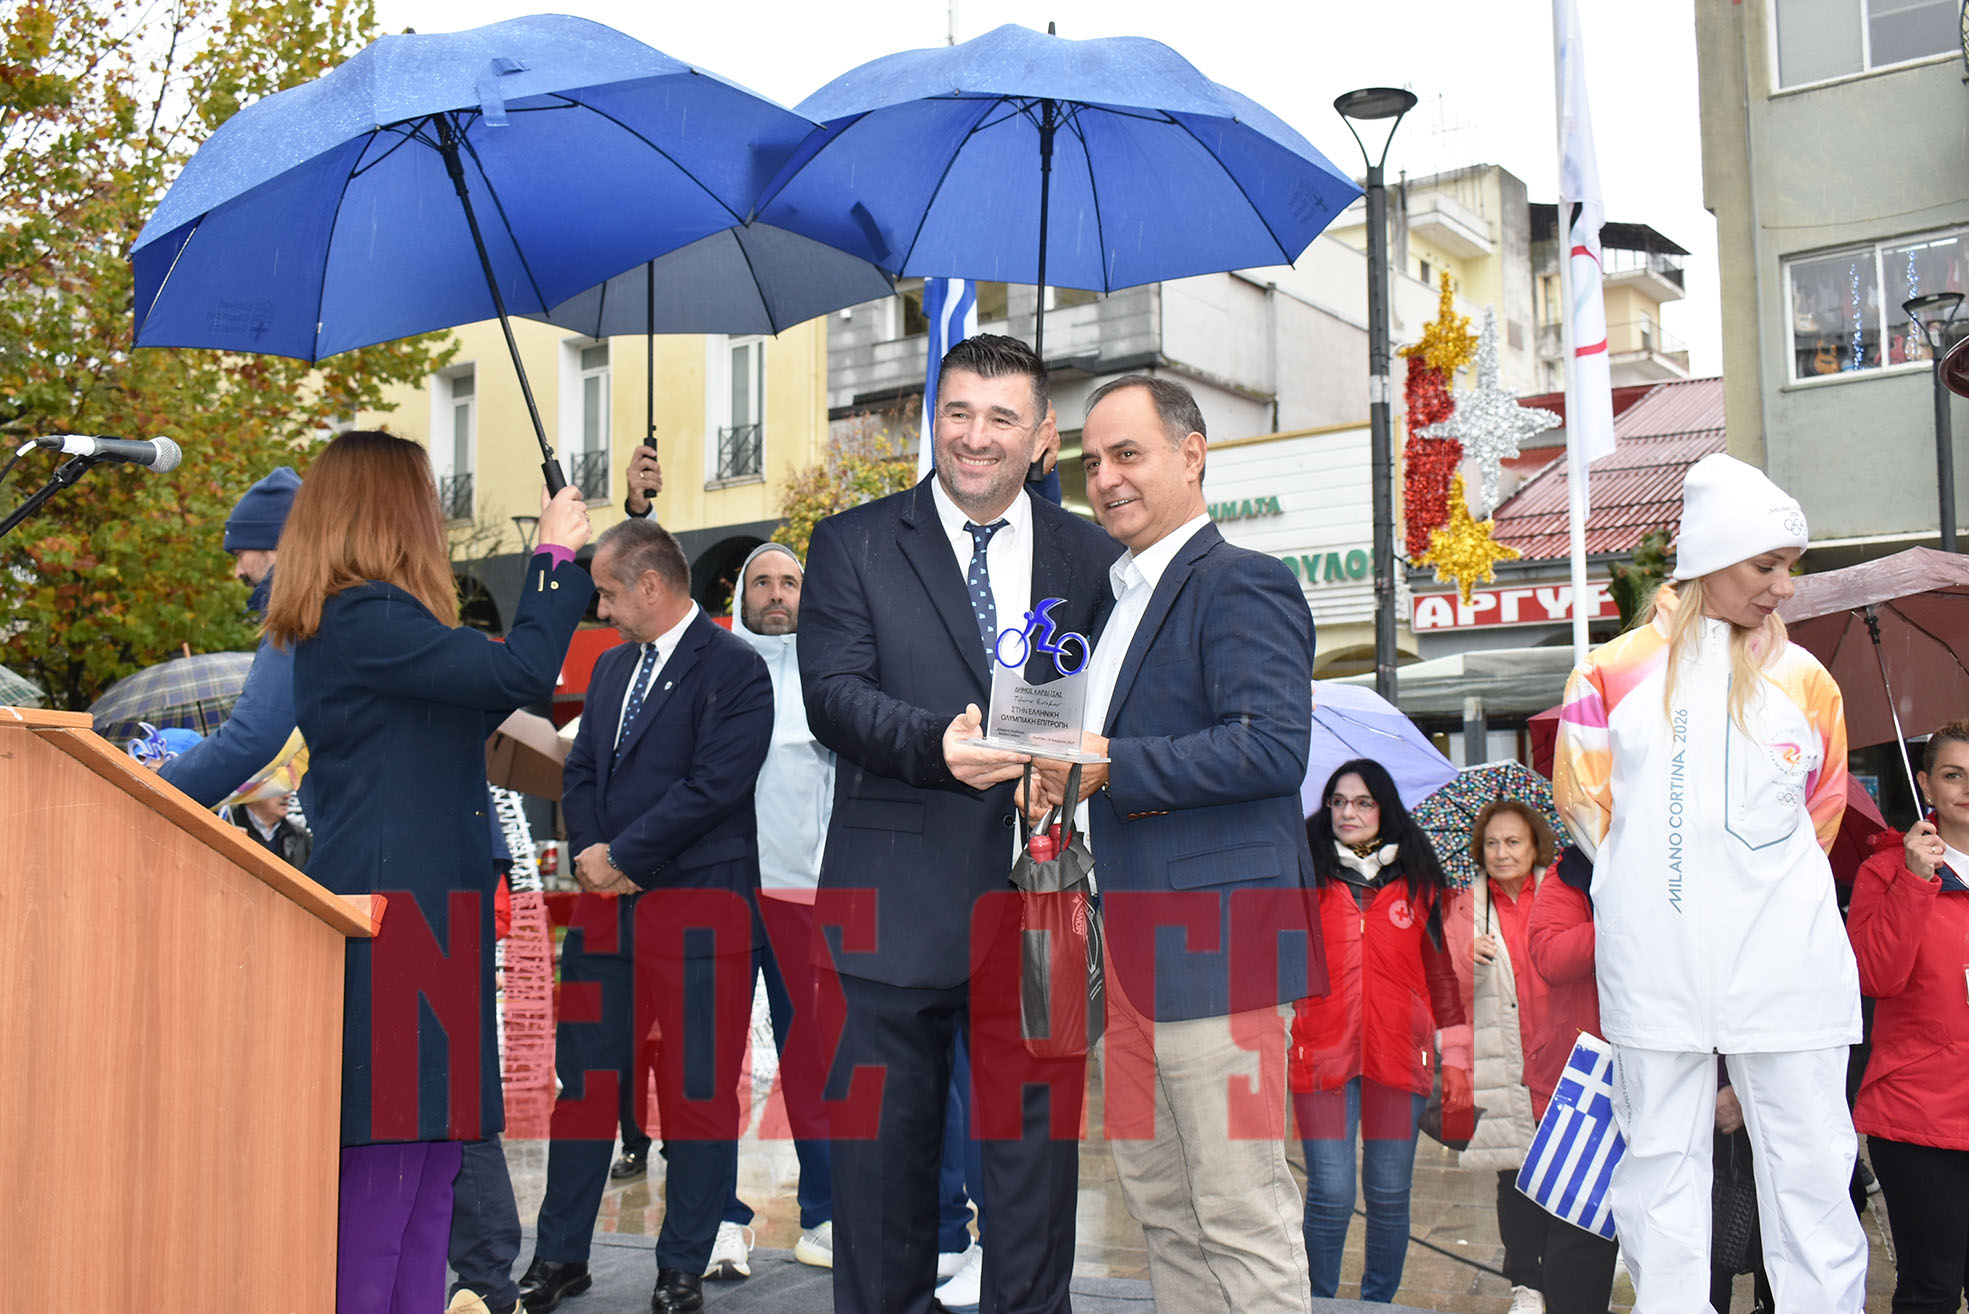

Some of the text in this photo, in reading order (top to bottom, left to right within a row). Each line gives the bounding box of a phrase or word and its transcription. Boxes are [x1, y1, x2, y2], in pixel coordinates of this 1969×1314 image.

[1282, 549, 1375, 583] ΟΥΛΟ
[1000, 714, 1069, 729] ΟΛΥΜΠΙΑΚΗ ΕΠΙΤΡΟΠΗ
[1011, 706, 1060, 718] ΣΤΗΝ ΕΛΛΗΝΙΚΗ
[1668, 708, 1688, 914] MILANO CORTINA 2026
